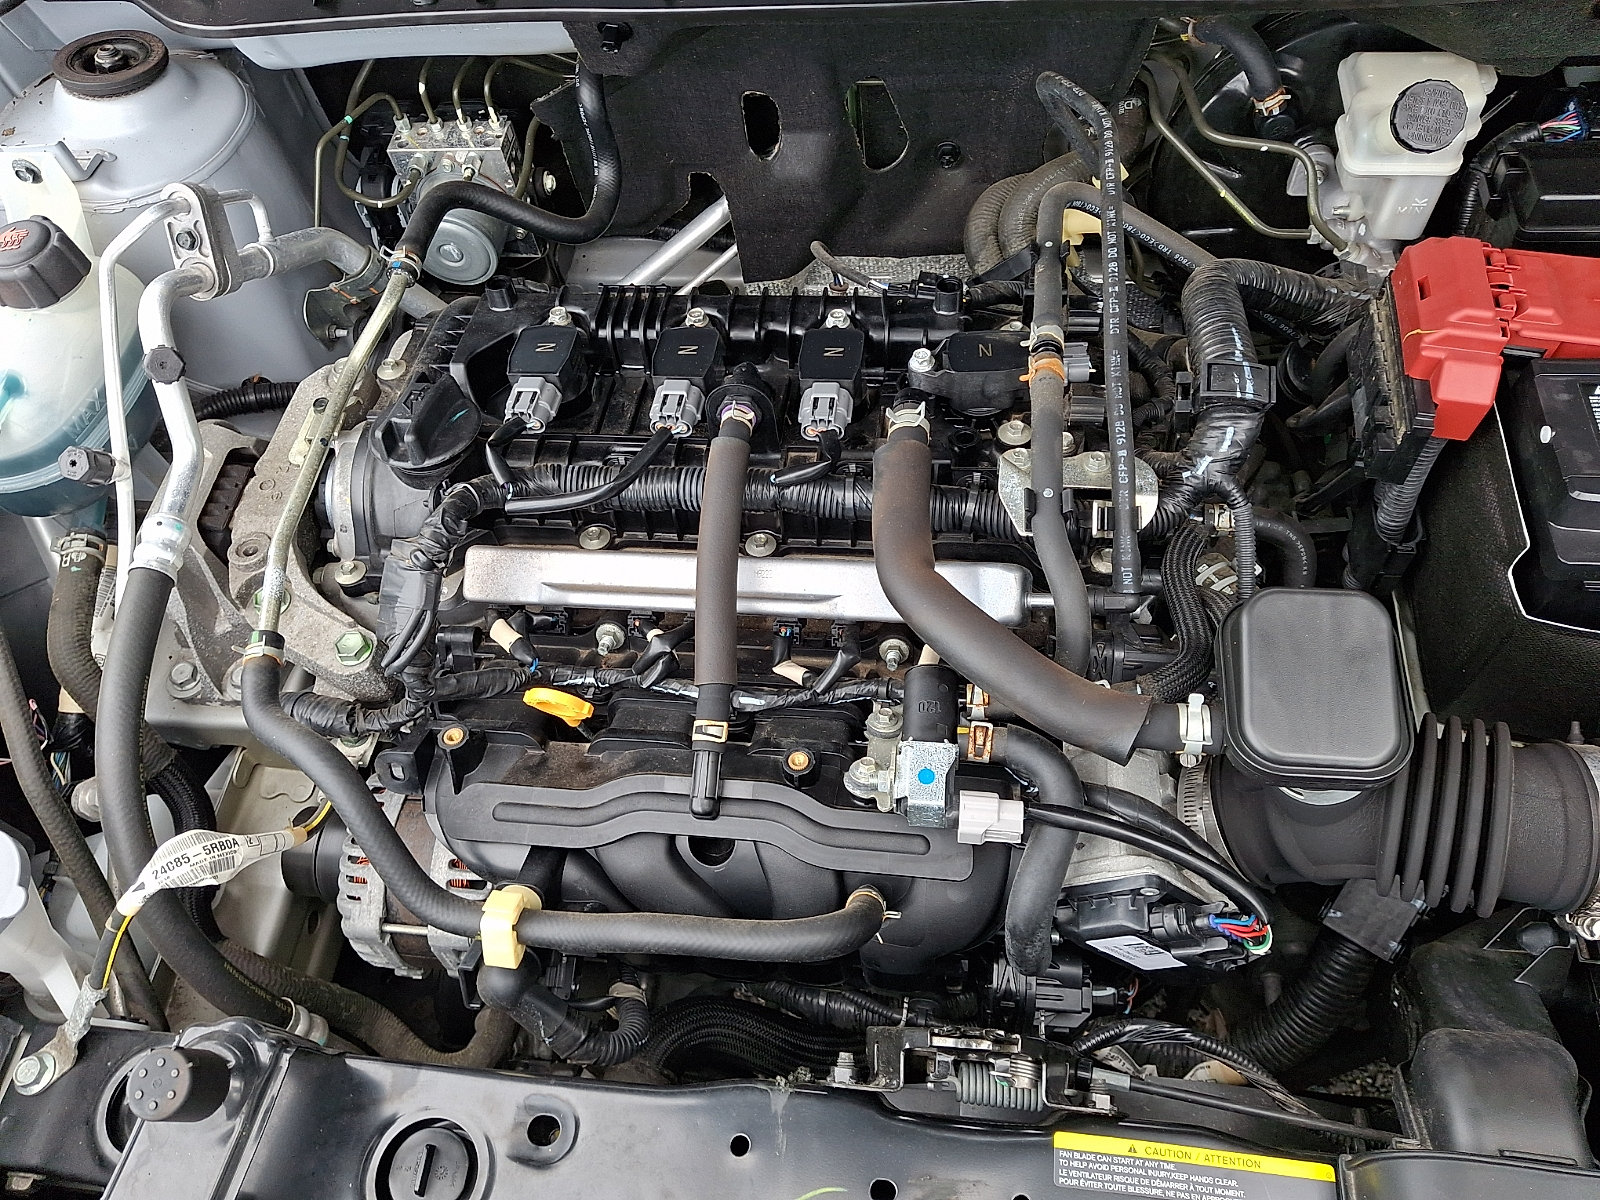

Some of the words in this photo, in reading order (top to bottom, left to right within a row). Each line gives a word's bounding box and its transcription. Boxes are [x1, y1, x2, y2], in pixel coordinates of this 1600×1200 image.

[1107, 230, 1117, 245] NOT
[1108, 246, 1118, 260] DO
[978, 343, 993, 357] N
[1122, 567, 1133, 585] NOT
[1060, 1150, 1072, 1158] FAN
[1074, 1152, 1096, 1160] BLADE
[1096, 1155, 1112, 1163] CAN
[1113, 1157, 1134, 1165] START
[1144, 1160, 1158, 1169] ANY
[1159, 1162, 1177, 1171] TIME.
[1144, 1146, 1192, 1160] CAUTION
[1204, 1154, 1261, 1168] ATTENTION
[1068, 1170, 1112, 1182] VENTILATEUR
[1114, 1175, 1140, 1184] RISQUE
[1140, 1178, 1150, 1186] DE
[1151, 1179, 1188, 1190] DÉMARRER
[1190, 1182, 1194, 1191] À
[1195, 1185, 1213, 1193] TOUT
[1215, 1188, 1246, 1198] MOMENT.
[1070, 1160, 1088, 1168] HELP
[1088, 1162, 1109, 1170] AVOID
[1111, 1165, 1147, 1176] PERSONAL
[1190, 1175, 1213, 1184] HANDS
[1215, 1178, 1238, 1187] CLEAR.
[1059, 1177, 1079, 1186] POUR
[1080, 1178, 1103, 1189] ÉVITER
[1104, 1182, 1127, 1192] TOUTE
[1128, 1186, 1165, 1198] BLESSURE,
[1166, 1190, 1175, 1198] NE
[1176, 1191, 1190, 1200] PAS
